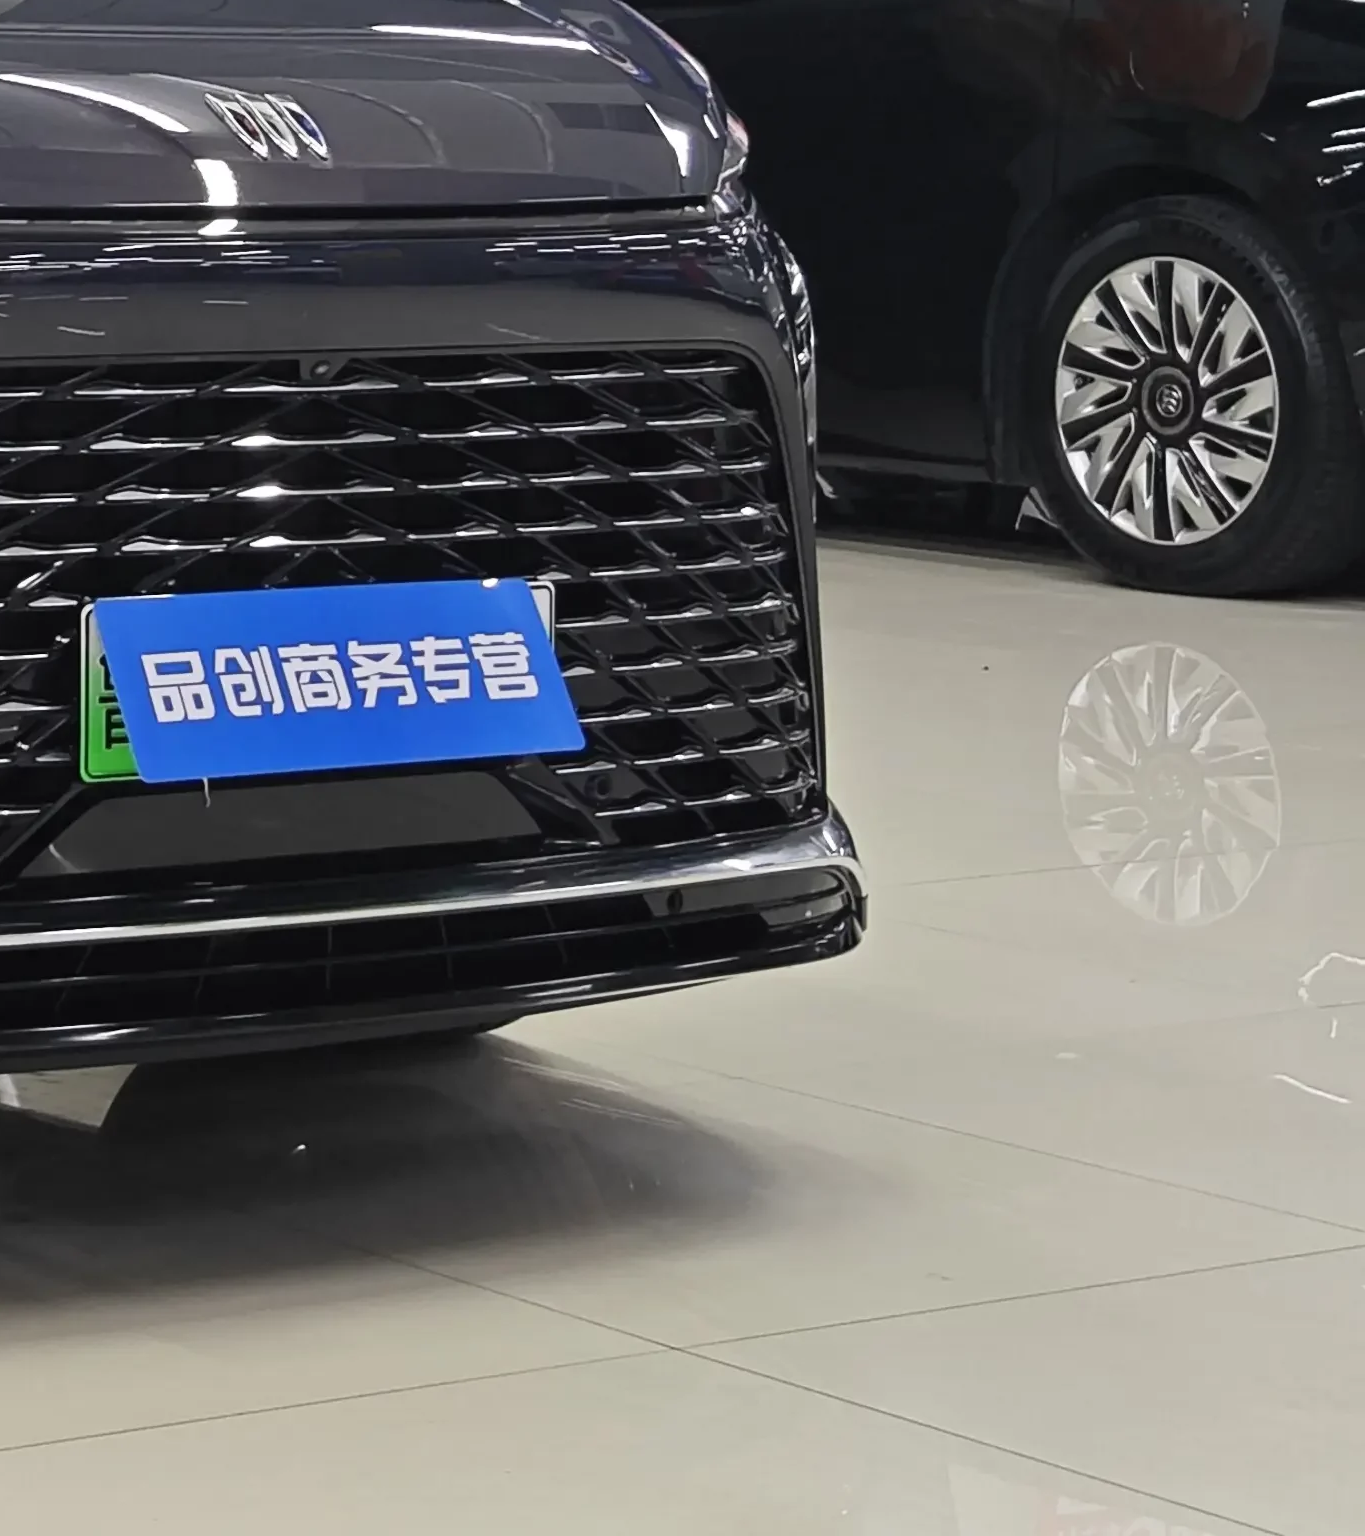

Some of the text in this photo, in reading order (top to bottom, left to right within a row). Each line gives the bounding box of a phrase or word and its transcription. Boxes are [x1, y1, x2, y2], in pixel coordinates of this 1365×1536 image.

[140, 631, 539, 724] 品创商务专营
